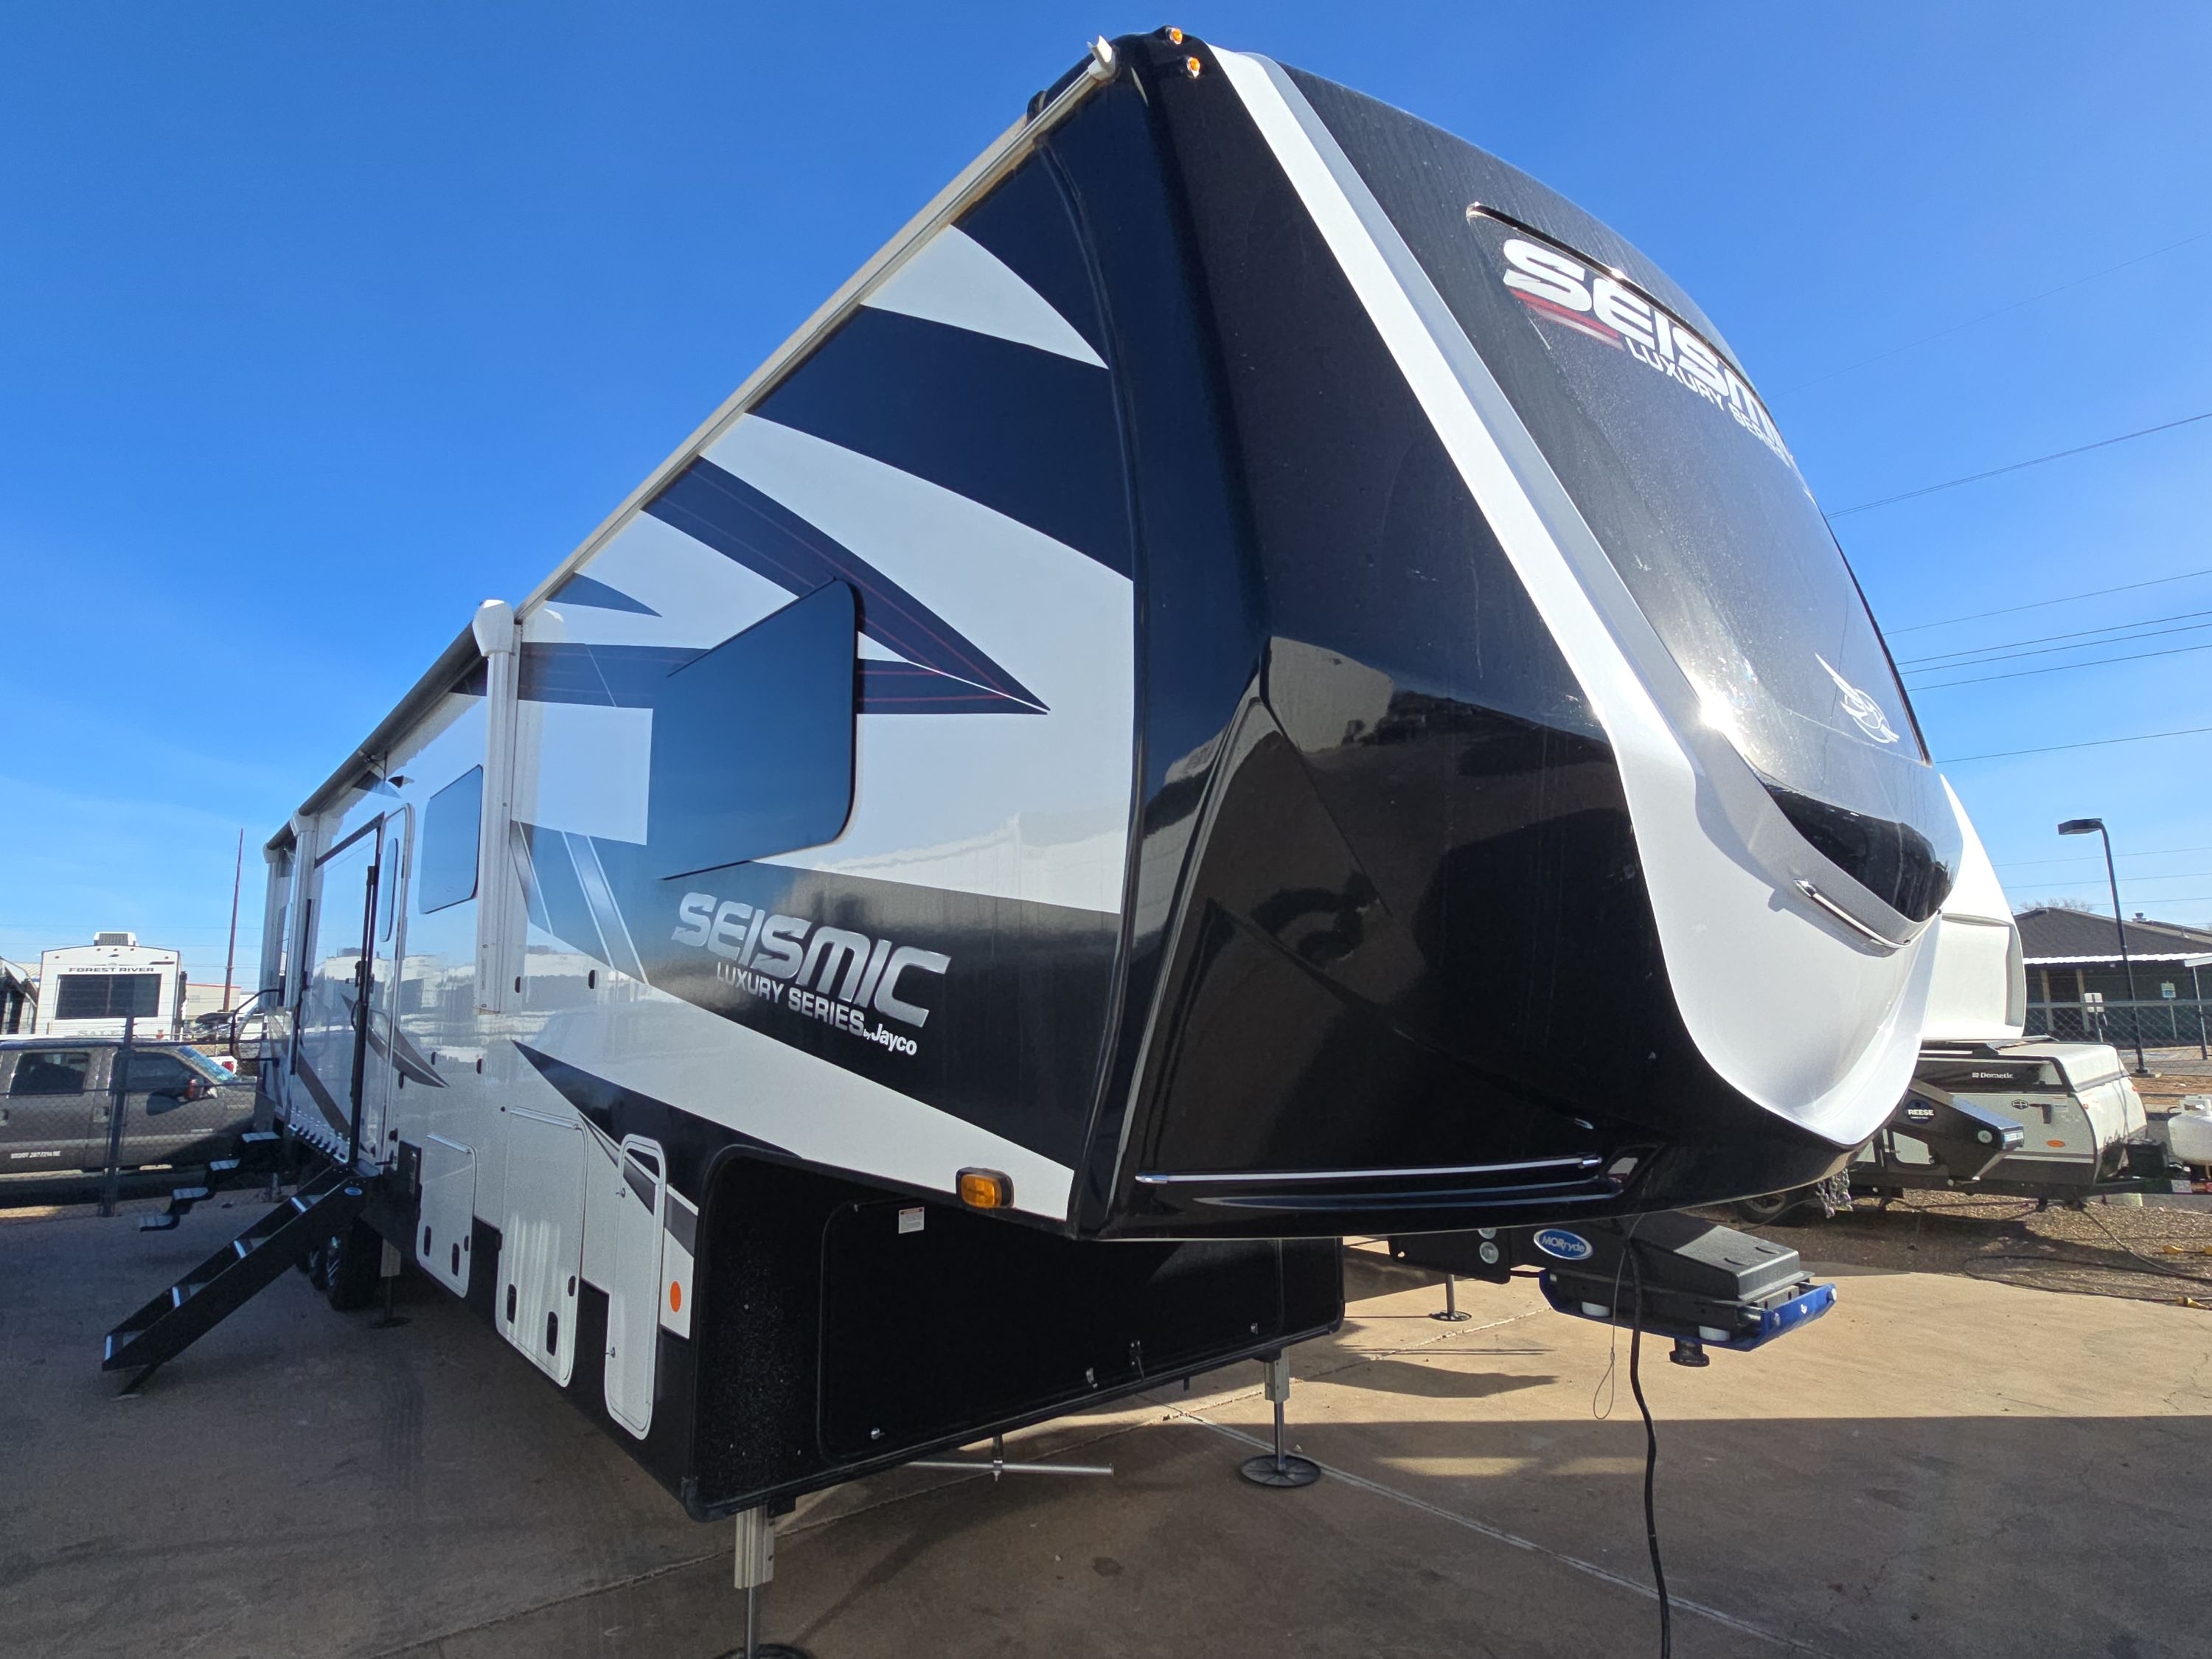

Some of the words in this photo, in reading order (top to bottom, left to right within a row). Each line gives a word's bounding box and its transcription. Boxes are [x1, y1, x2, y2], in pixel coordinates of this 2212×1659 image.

[1503, 239, 1792, 462] SEISMI
[1625, 336, 1724, 411] LUXURY
[671, 891, 951, 1028] SEISMIC
[717, 961, 785, 1004] LUXURY
[787, 988, 865, 1037] SERIES
[871, 1023, 917, 1056] Jayco
[1540, 1235, 1585, 1253] MORryde
